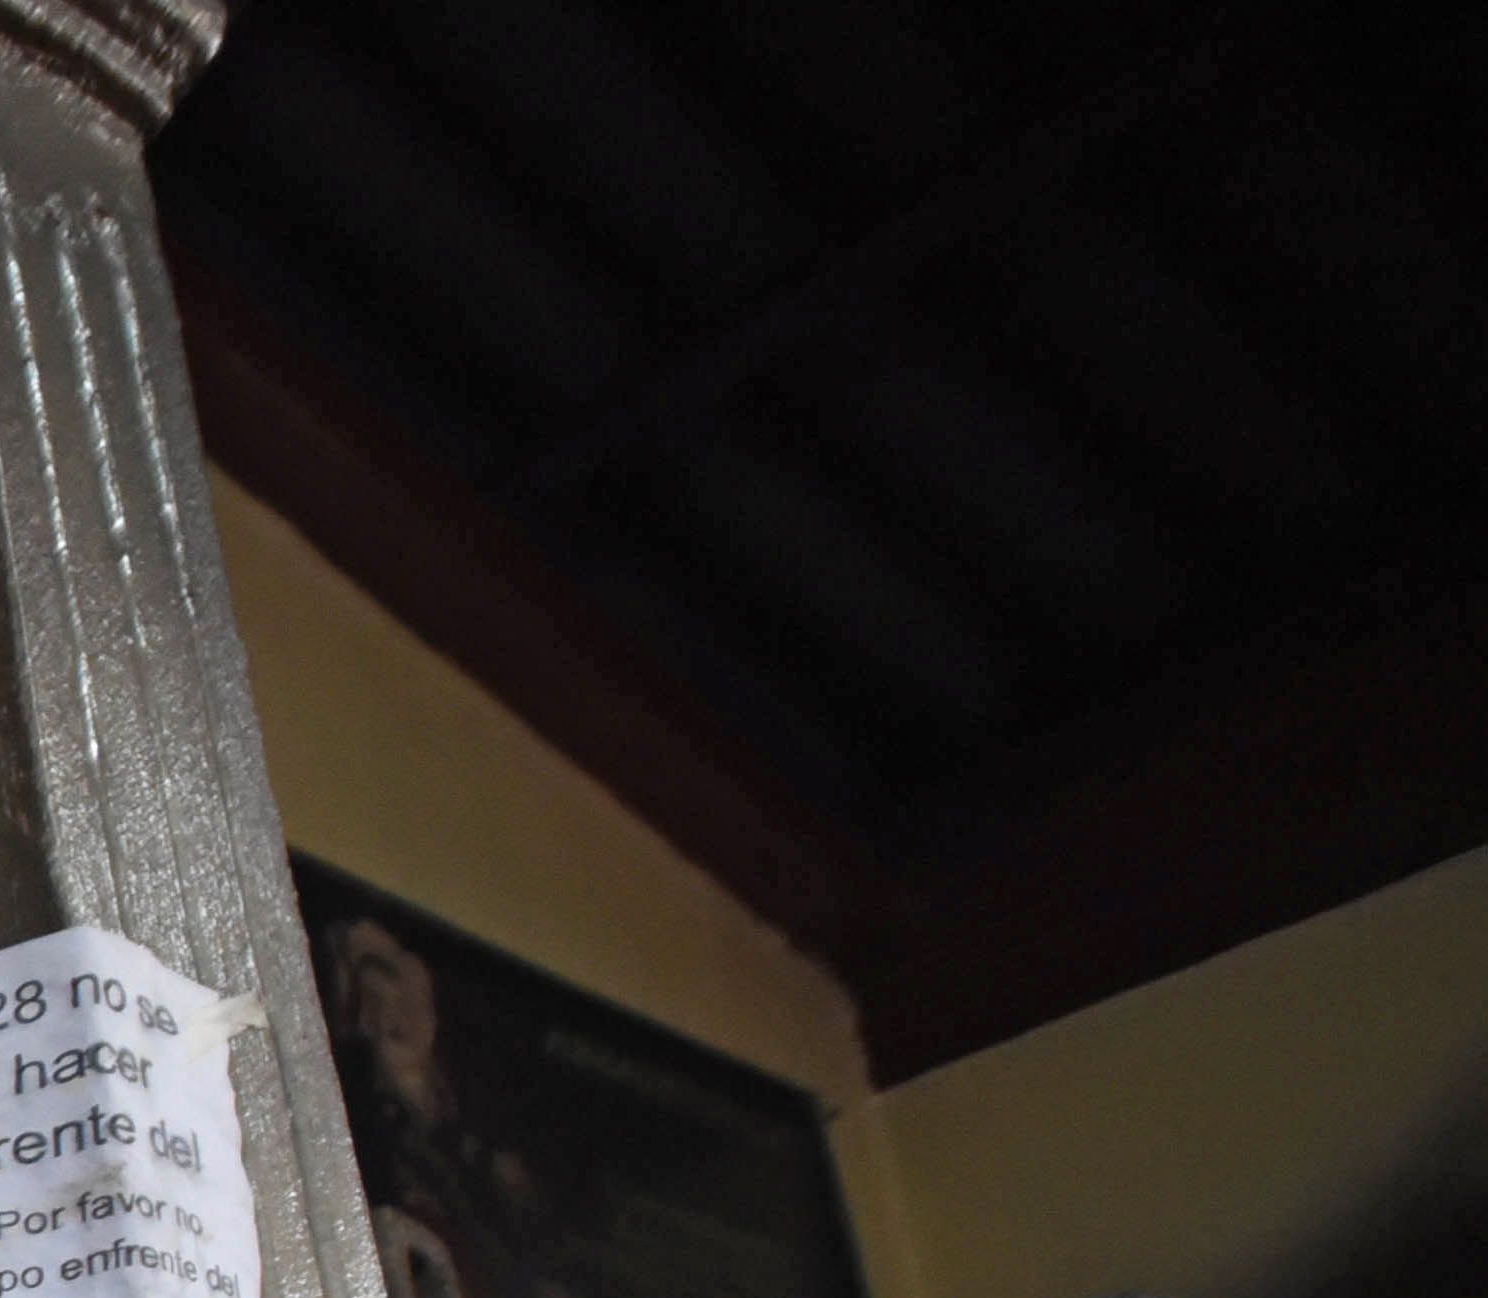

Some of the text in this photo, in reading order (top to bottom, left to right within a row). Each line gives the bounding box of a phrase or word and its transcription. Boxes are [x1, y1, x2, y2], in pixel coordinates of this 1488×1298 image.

[69, 972, 126, 1013] no
[137, 994, 179, 1036] se
[13, 1040, 153, 1097] hacer
[149, 1120, 203, 1175] del
[76, 1190, 166, 1223] favor
[175, 1206, 204, 1238] no
[60, 1237, 198, 1282] enfrente
